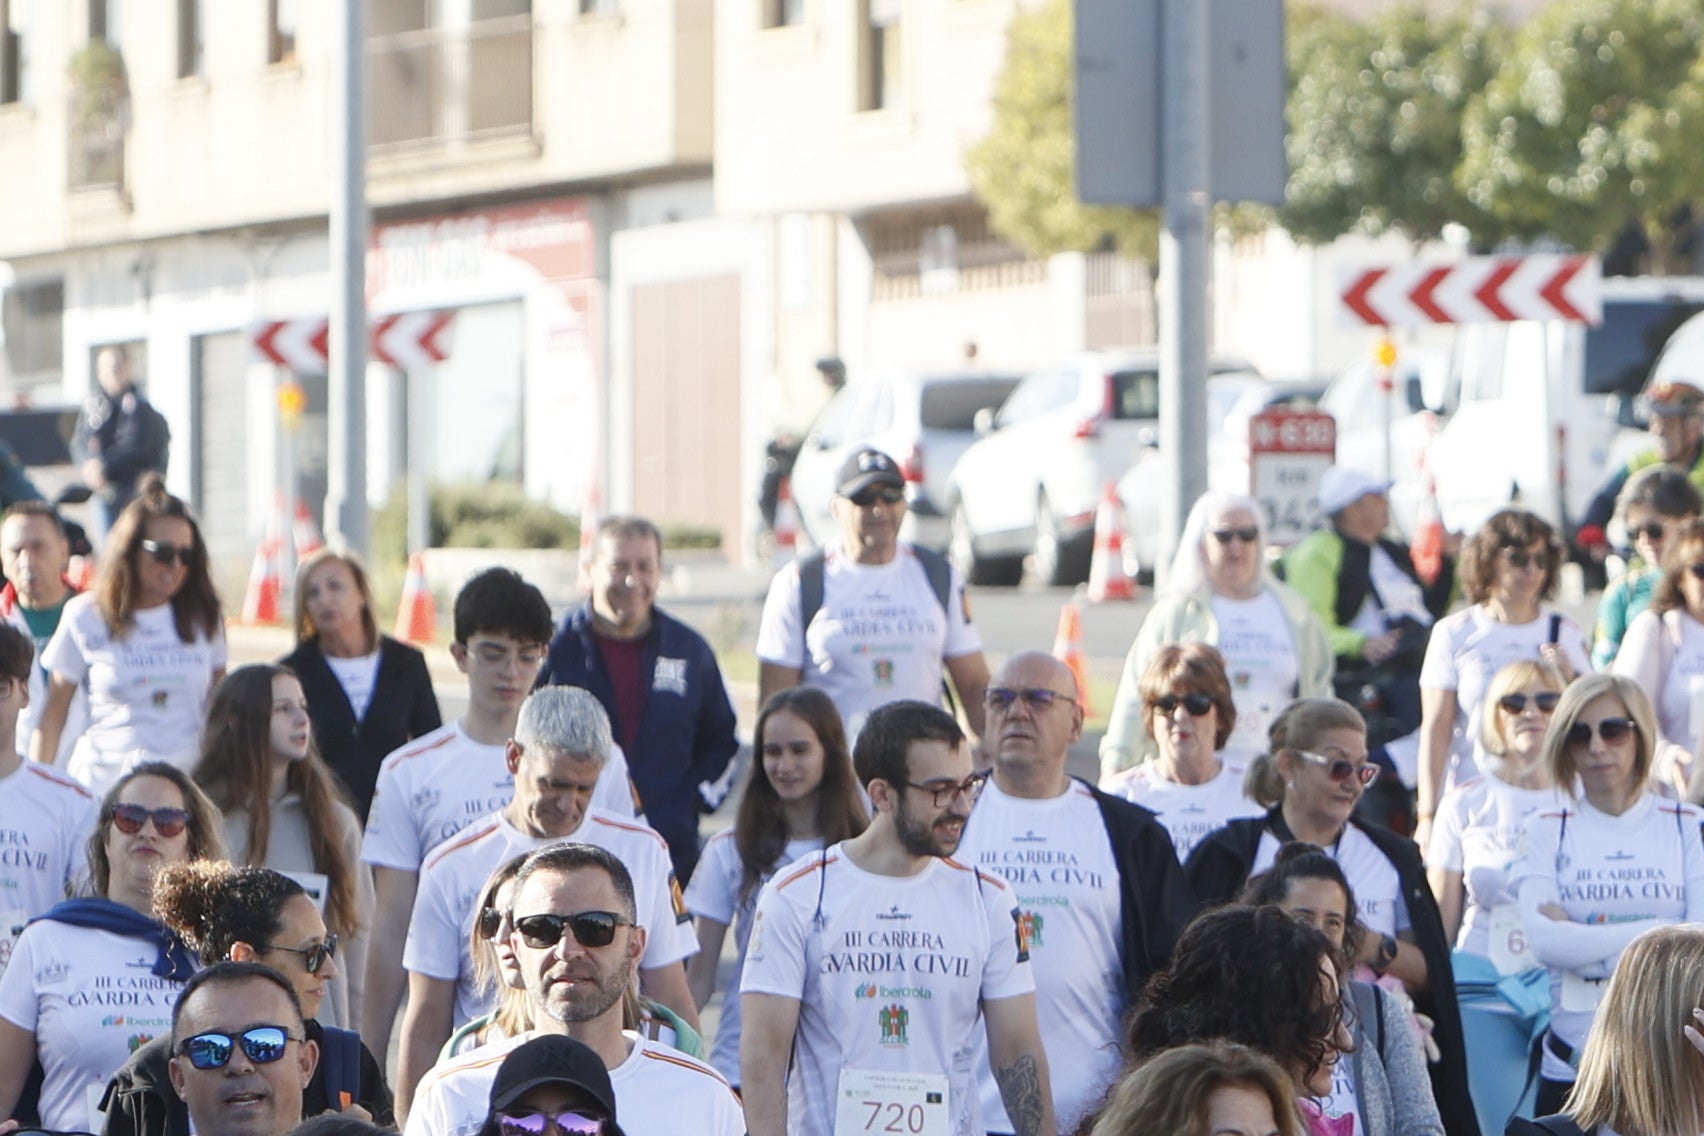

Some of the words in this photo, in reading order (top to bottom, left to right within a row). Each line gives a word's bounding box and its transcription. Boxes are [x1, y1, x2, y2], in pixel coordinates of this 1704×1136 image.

[1003, 849, 1079, 866] CARRERA
[1051, 868, 1107, 889] CIVIL
[868, 930, 945, 949] CARRERA
[914, 953, 970, 977] CIVIL
[862, 1101, 925, 1133] 720
